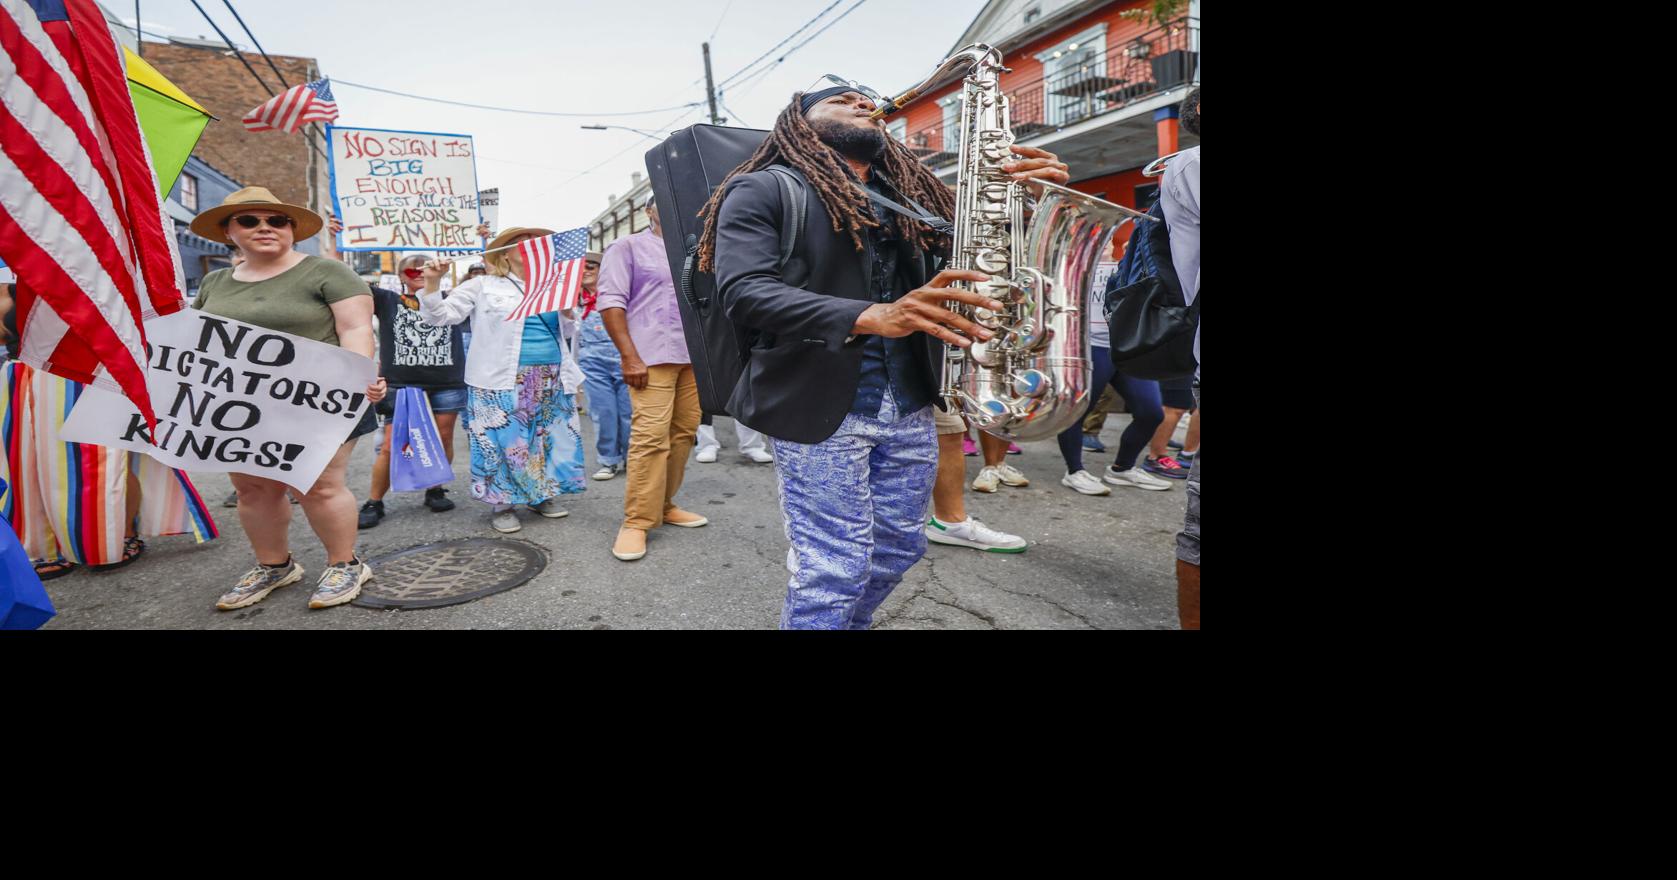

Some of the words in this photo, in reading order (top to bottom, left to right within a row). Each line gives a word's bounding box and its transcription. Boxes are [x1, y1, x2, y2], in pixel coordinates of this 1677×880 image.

[343, 132, 385, 159] NO
[388, 137, 437, 158] SIGN
[444, 140, 471, 158] IS
[368, 159, 423, 176] BIG
[356, 177, 454, 195] ENOUGH
[341, 195, 367, 207] TO
[374, 195, 411, 207] LIST
[416, 192, 441, 208] ALL
[456, 194, 477, 210] THE
[370, 207, 460, 226] REASONS
[348, 225, 378, 245] I
[387, 224, 431, 247] AM
[432, 223, 475, 247] HERE
[195, 315, 296, 367] NO
[395, 355, 454, 366] WOMEN
[168, 381, 262, 432] NO
[119, 413, 305, 471] KINGS!
